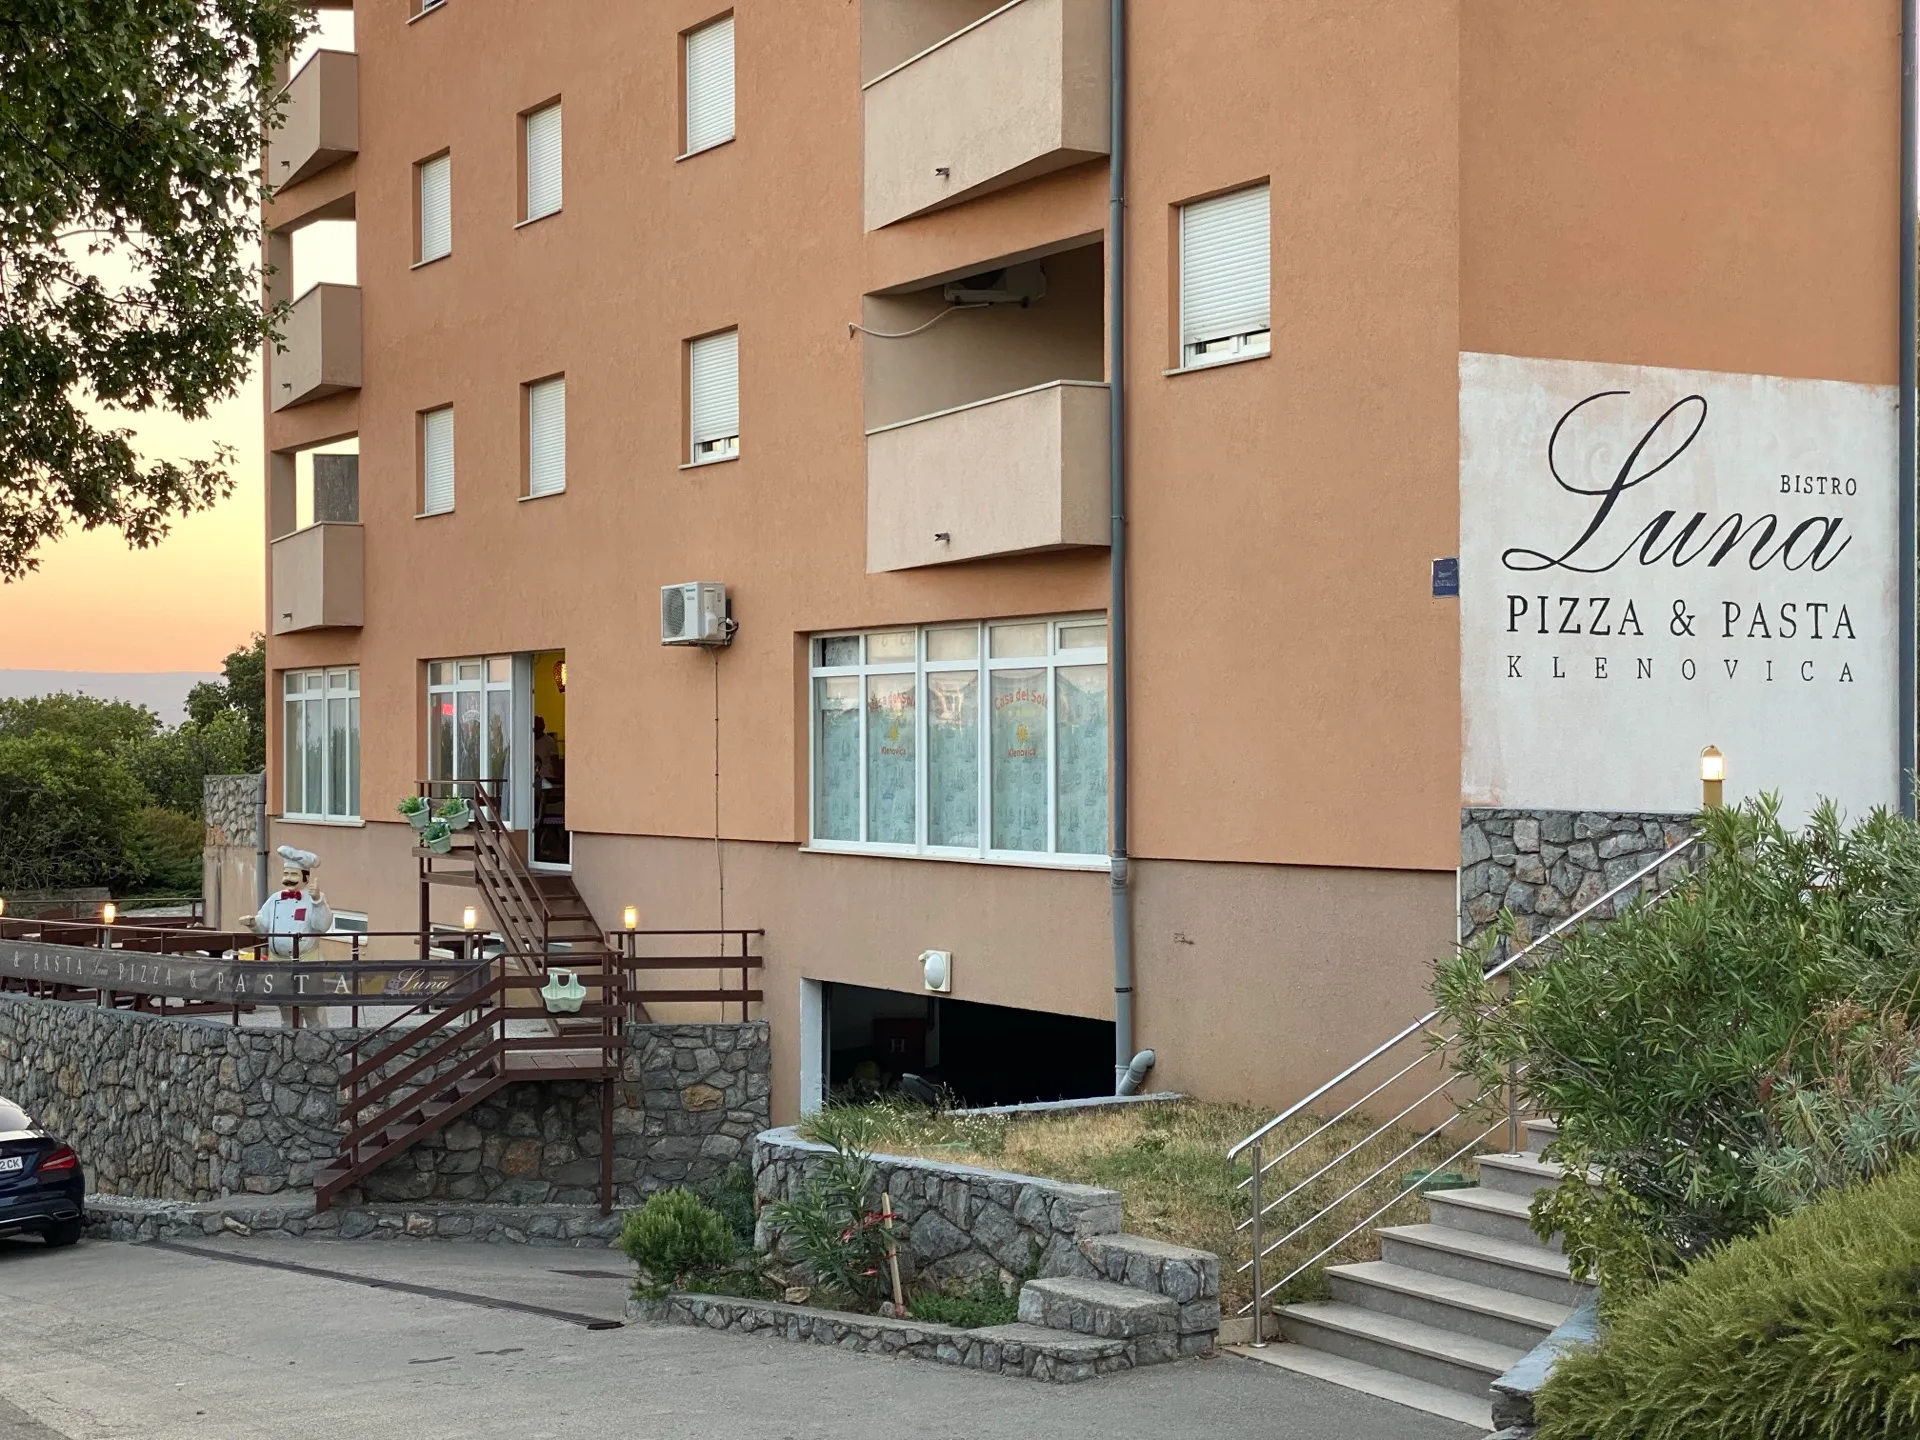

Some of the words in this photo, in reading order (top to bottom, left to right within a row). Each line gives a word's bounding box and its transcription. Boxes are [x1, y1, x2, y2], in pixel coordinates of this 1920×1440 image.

[1501, 390, 1853, 574] Luna
[1779, 474, 1858, 496] BISTRO
[1506, 594, 1645, 637] PIZZA
[1669, 598, 1697, 638] &
[1721, 600, 1857, 641] PASTA
[1506, 654, 1855, 683] KLENOVICA
[994, 692, 1014, 711] Casa
[1015, 687, 1030, 702] del
[13, 950, 20, 968] &
[33, 952, 83, 975] PASTA
[118, 962, 171, 986] PIZZA
[189, 969, 198, 989] &
[217, 971, 352, 994] PASTA
[397, 967, 450, 992] Luna
[890, 1038, 905, 1053] H
